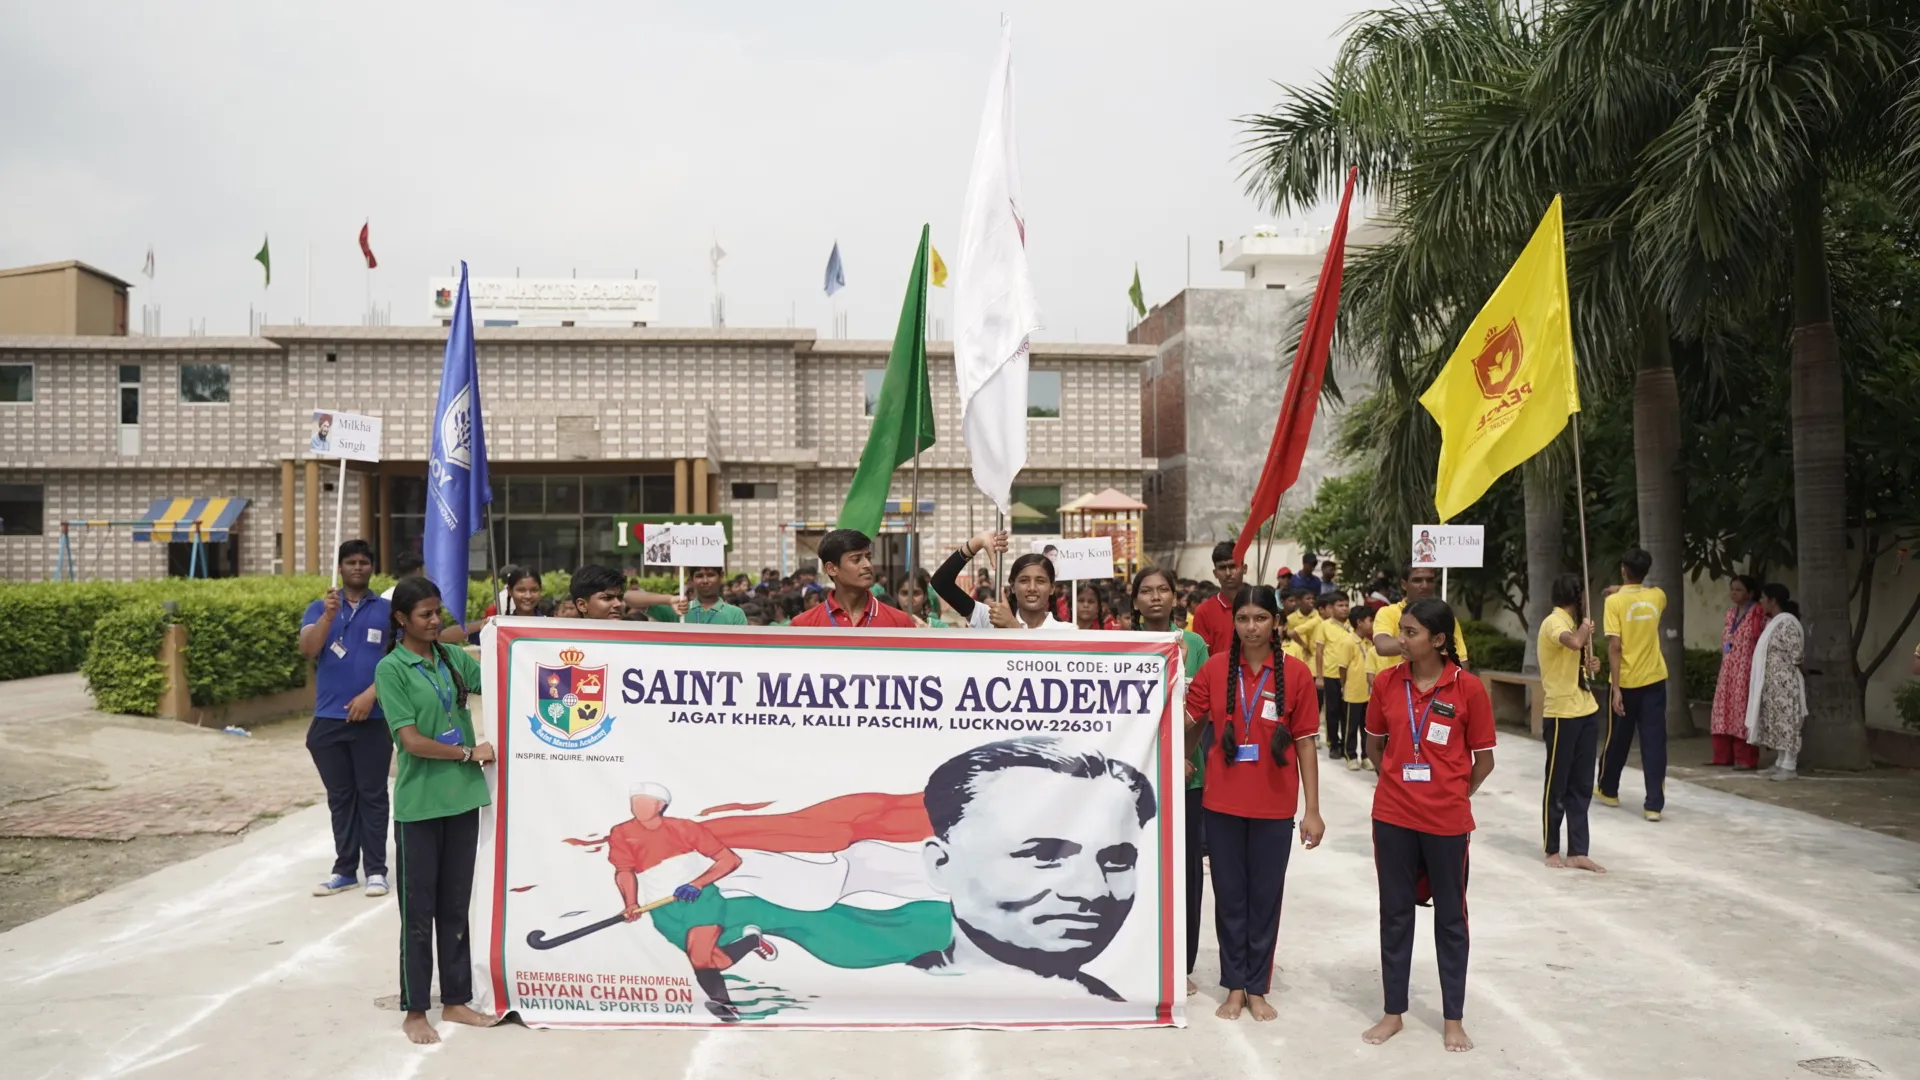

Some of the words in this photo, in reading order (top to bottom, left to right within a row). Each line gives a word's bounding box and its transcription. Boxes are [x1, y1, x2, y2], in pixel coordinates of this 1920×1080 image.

[338, 418, 372, 433] Milkha
[338, 439, 366, 453] Singh
[429, 452, 453, 487] JOY
[671, 535, 699, 548] Kapil
[701, 536, 721, 546] Dev
[1458, 536, 1480, 546] Usha
[1060, 550, 1085, 561] Mary
[1088, 548, 1112, 558] Kom
[1006, 660, 1063, 673] SCHOOL
[1067, 661, 1109, 674] CODE:
[1113, 662, 1132, 674] UP
[1136, 662, 1160, 674] 435
[621, 667, 744, 707] SAINT
[755, 671, 944, 712] MARTINS
[955, 676, 1159, 715] ACADEMY
[668, 711, 727, 725] JAGAT
[732, 713, 797, 728] KHERA,
[802, 714, 851, 727] KALLI
[857, 715, 944, 731] PASCHIM,
[950, 718, 1112, 733] LUCKNOW-226301
[536, 729, 552, 743] Saint
[553, 738, 578, 748] Martins
[580, 729, 607, 746] Academy
[515, 752, 549, 761] INSPIRE,
[550, 754, 584, 762] INQUIRE,
[586, 755, 625, 763] INNOVATE
[516, 970, 594, 984] REMEMBERING
[597, 974, 617, 985] THE
[620, 975, 692, 987] PHENOMENAL
[517, 982, 584, 999] DHYAN
[590, 985, 658, 1002] CHAND
[665, 988, 693, 1003] ON
[520, 997, 595, 1012] NATIONAL
[600, 1001, 660, 1014] SPORTS
[665, 1003, 694, 1014] DAY
